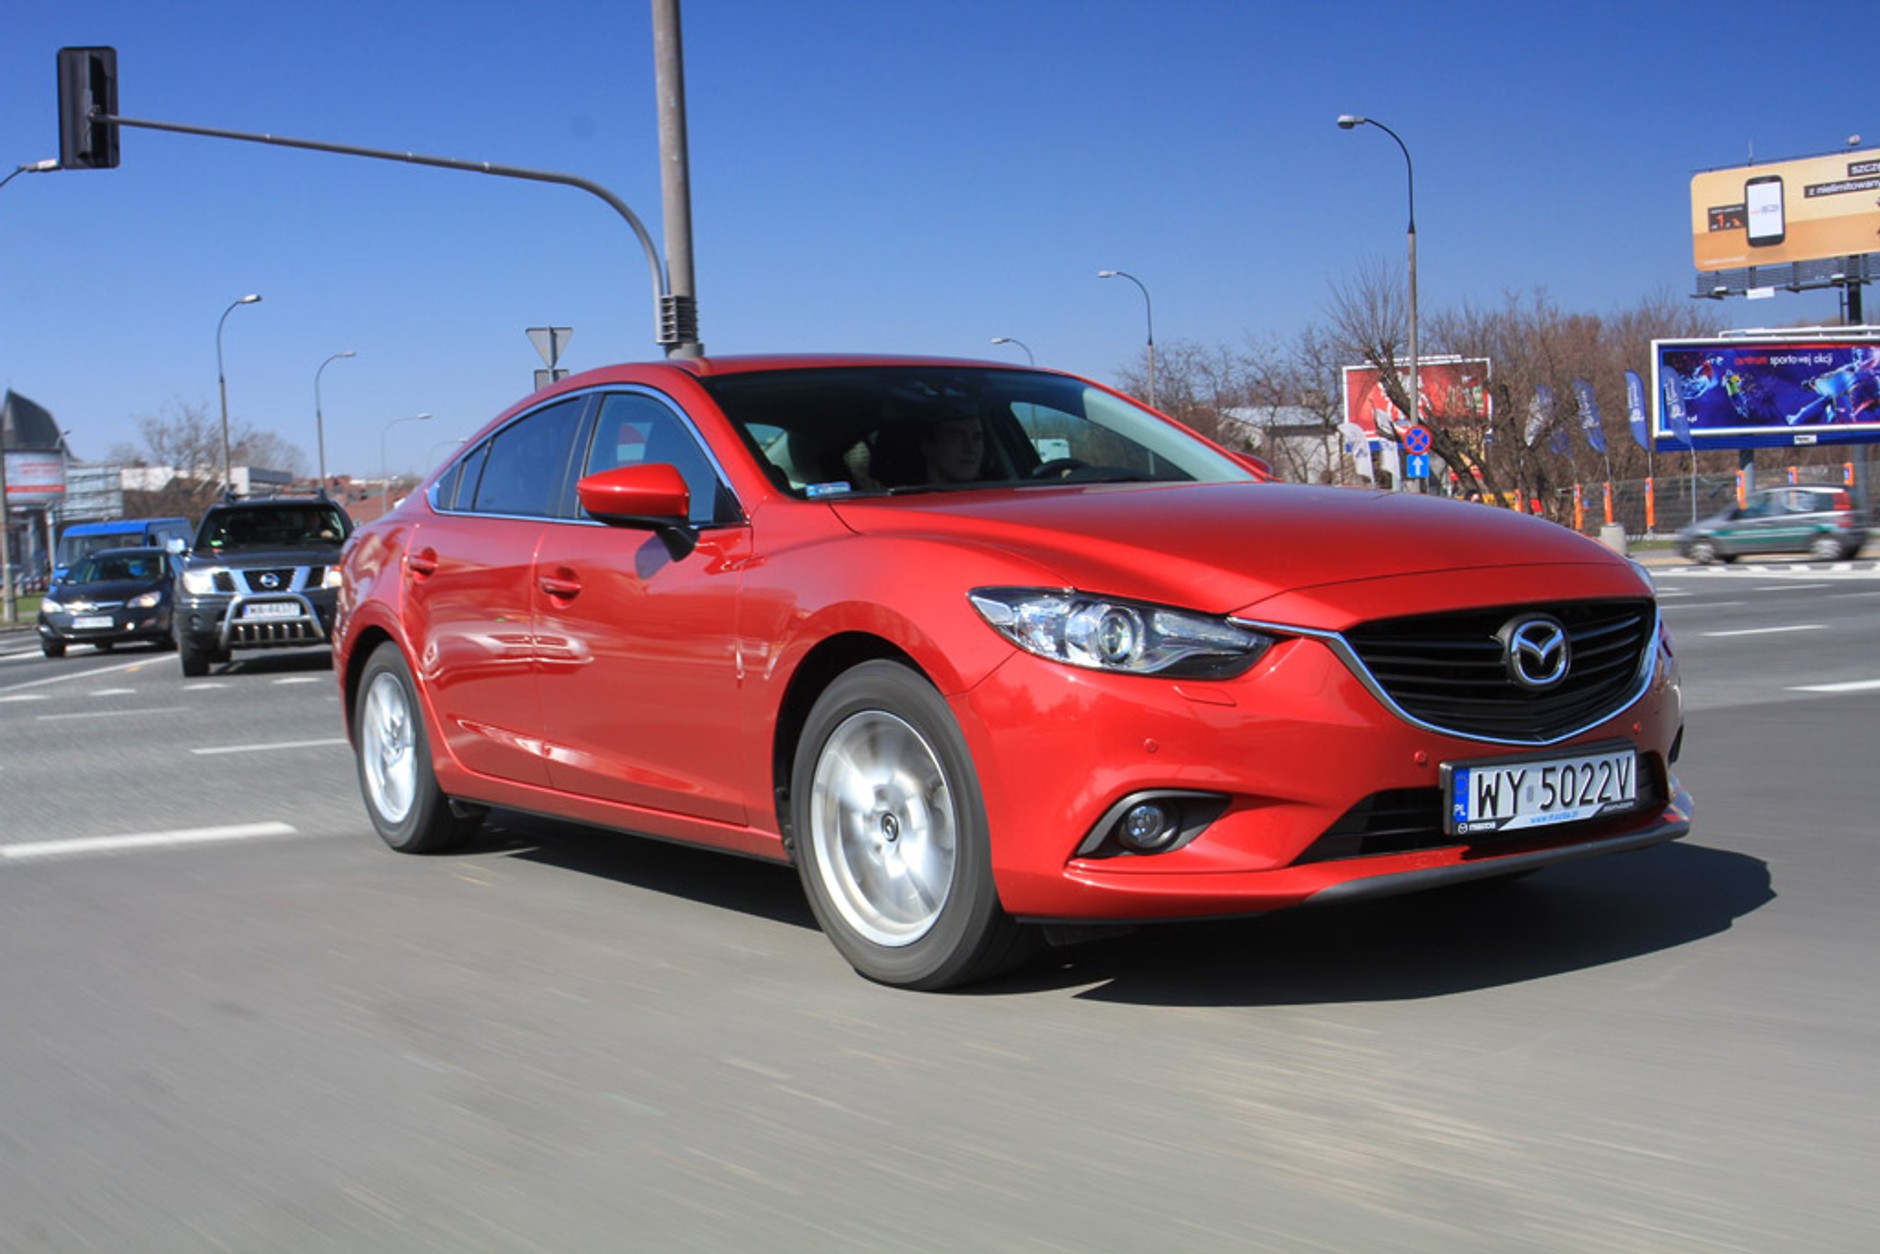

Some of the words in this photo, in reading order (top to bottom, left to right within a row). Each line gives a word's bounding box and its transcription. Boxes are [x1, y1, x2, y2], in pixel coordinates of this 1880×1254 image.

[1770, 353, 1811, 367] sportowej
[1477, 769, 1526, 819] WY
[1539, 757, 1630, 811] 5022V
[1454, 803, 1466, 816] PL
